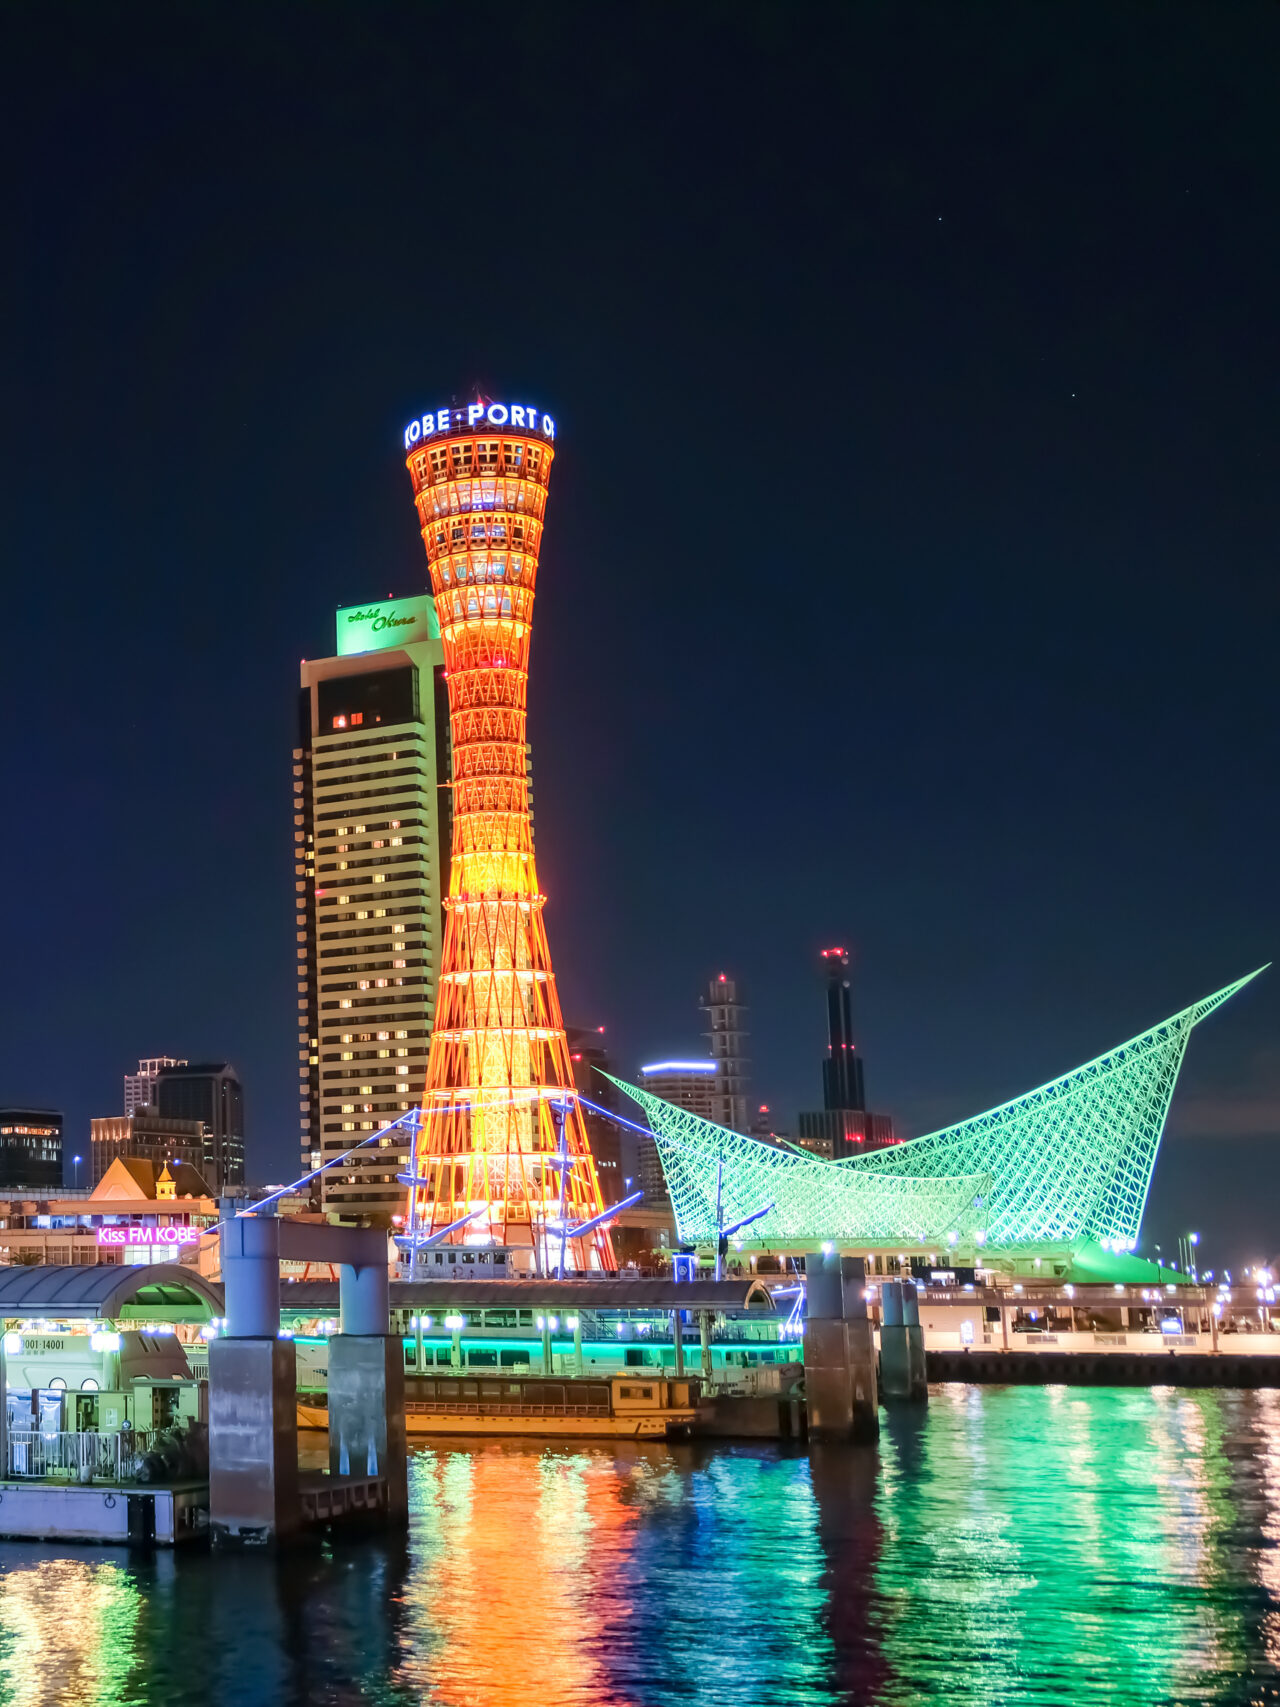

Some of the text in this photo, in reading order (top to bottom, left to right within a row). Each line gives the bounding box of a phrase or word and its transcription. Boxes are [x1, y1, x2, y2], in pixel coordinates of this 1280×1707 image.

[404, 408, 450, 449] KOBE
[468, 403, 536, 429] PORT
[371, 610, 417, 632] Okura
[98, 1226, 197, 1243] Kiss FM KOBE
